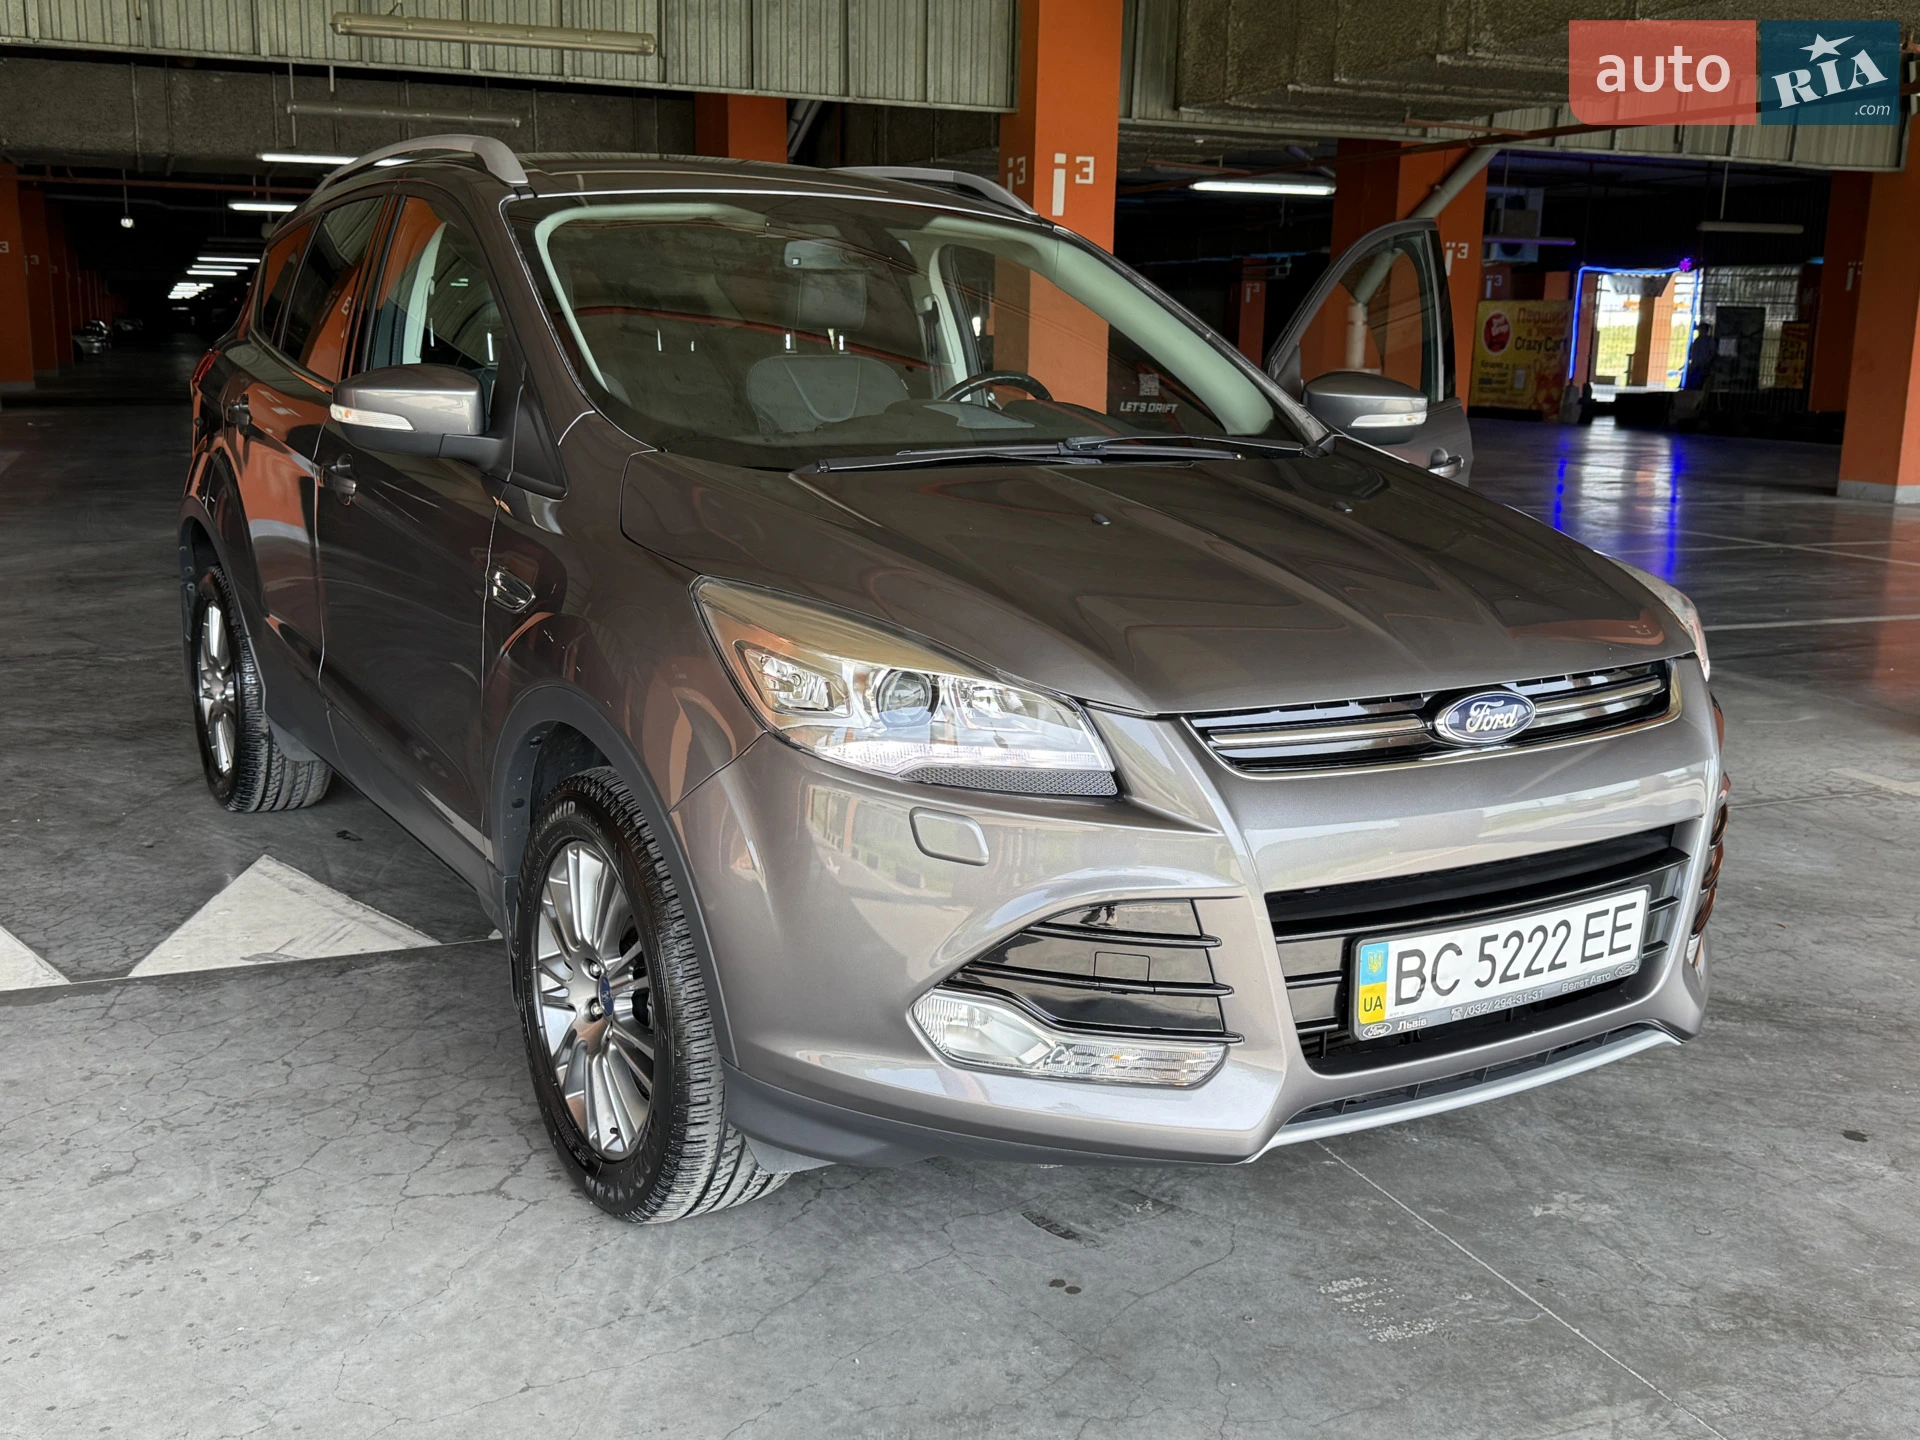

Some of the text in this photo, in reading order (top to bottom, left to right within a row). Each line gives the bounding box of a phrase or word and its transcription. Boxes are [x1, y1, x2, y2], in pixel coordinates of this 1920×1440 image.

[1514, 336, 1541, 353] Crazy
[1120, 401, 1178, 414] LET'S DRIFT
[1466, 700, 1518, 733] Ford
[1395, 901, 1637, 1007] BC 5222 EE
[1363, 996, 1383, 1013] UA
[1397, 1017, 1427, 1031] Львів
